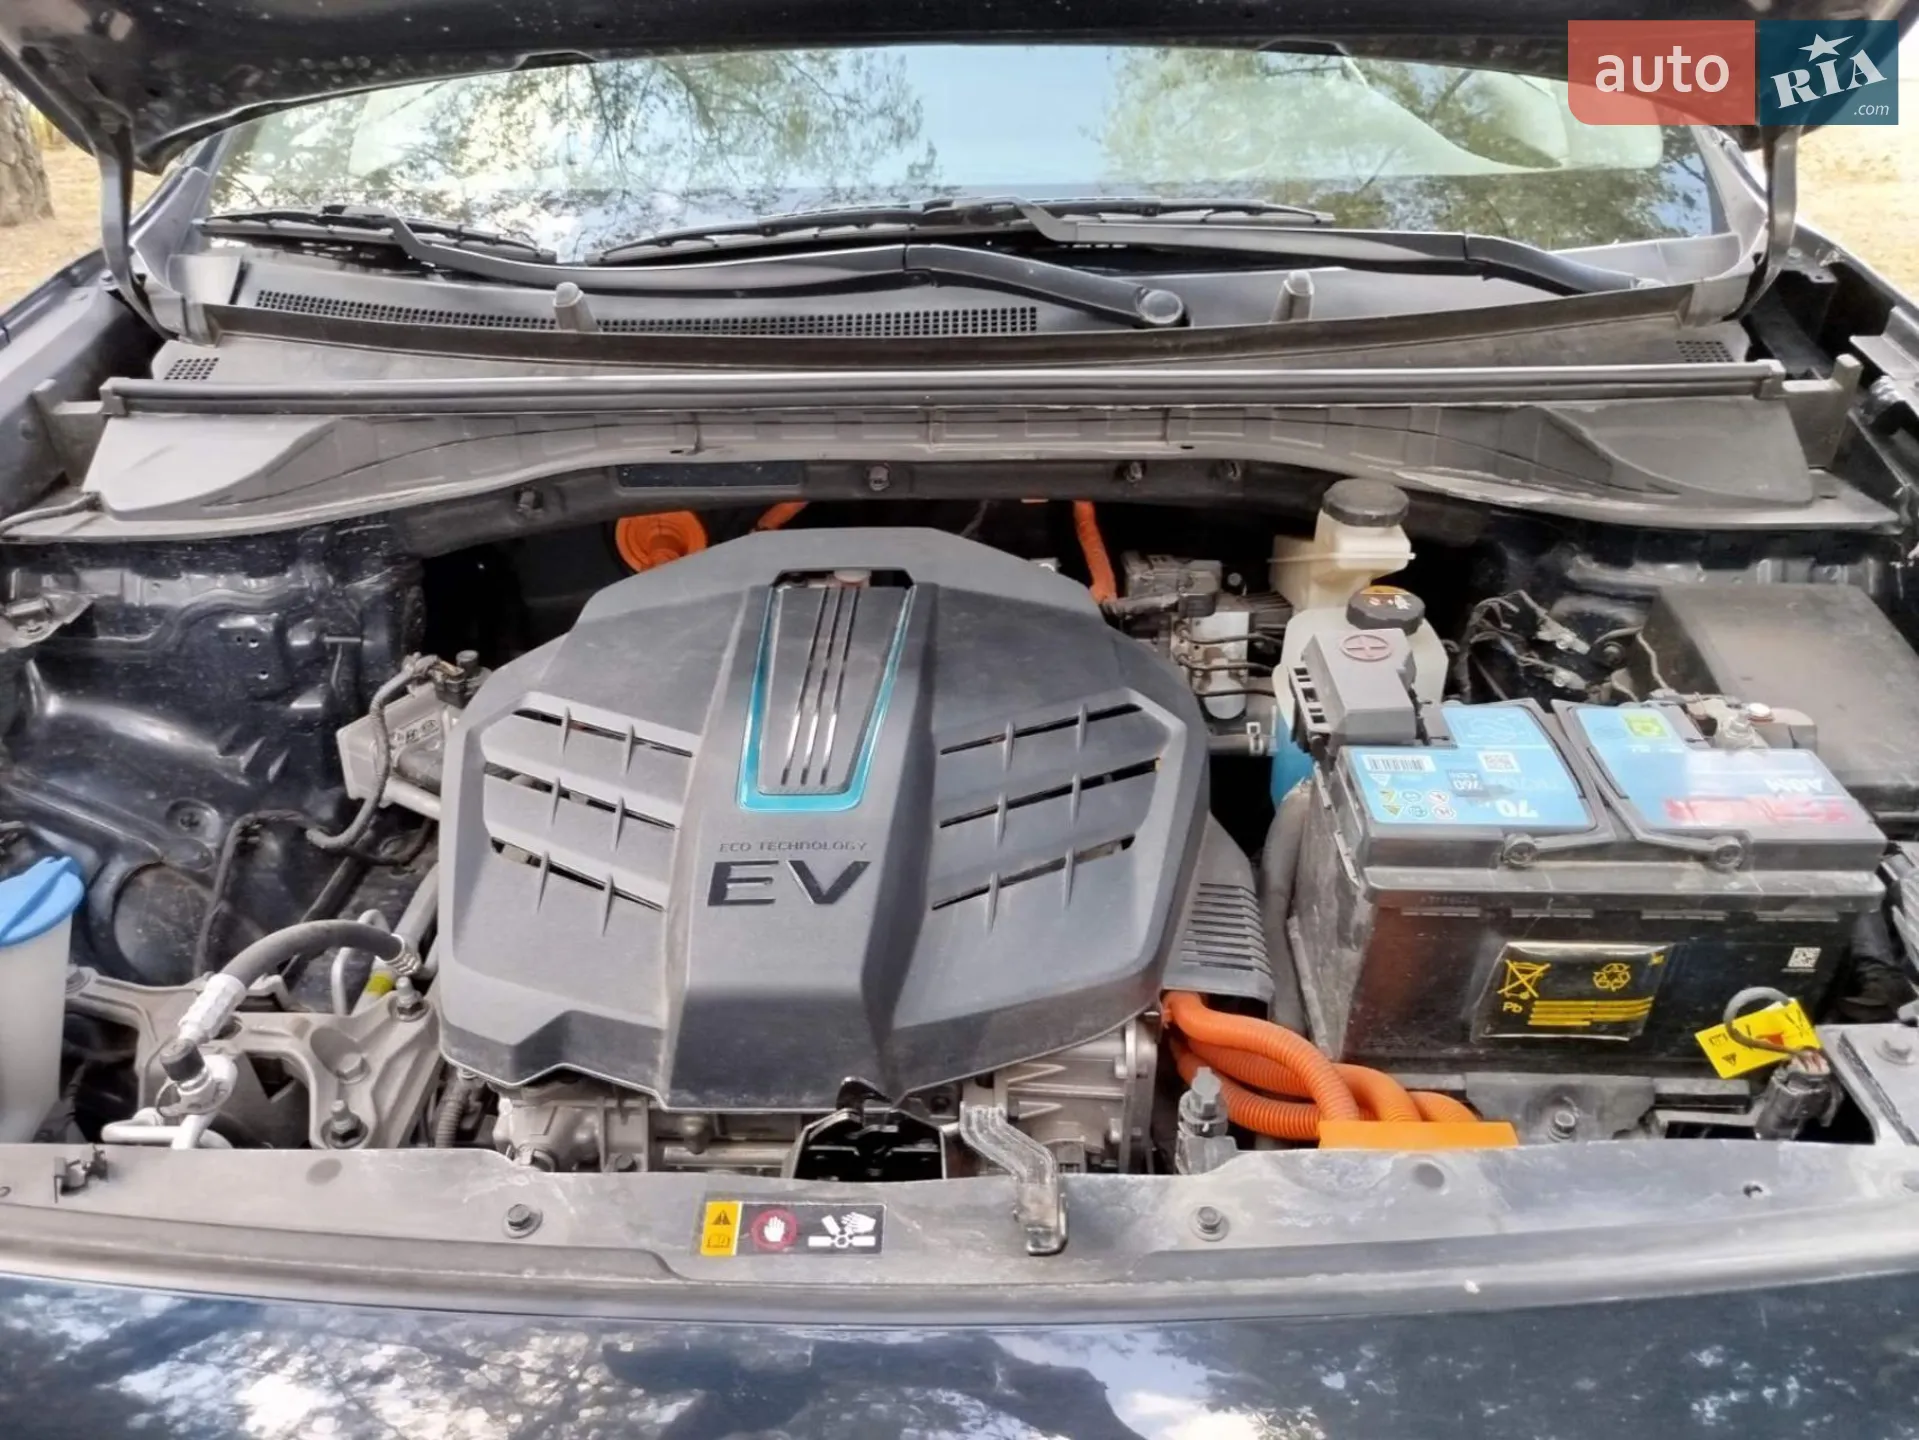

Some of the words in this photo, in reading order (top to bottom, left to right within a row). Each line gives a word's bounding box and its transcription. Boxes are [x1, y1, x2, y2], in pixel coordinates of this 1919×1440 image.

[1452, 777, 1486, 791] 760
[1494, 799, 1540, 819] 70
[719, 842, 752, 853] ECO
[759, 841, 868, 852] TECHNOLOGY
[707, 860, 872, 907] EV
[1502, 1001, 1523, 1014] Pb
